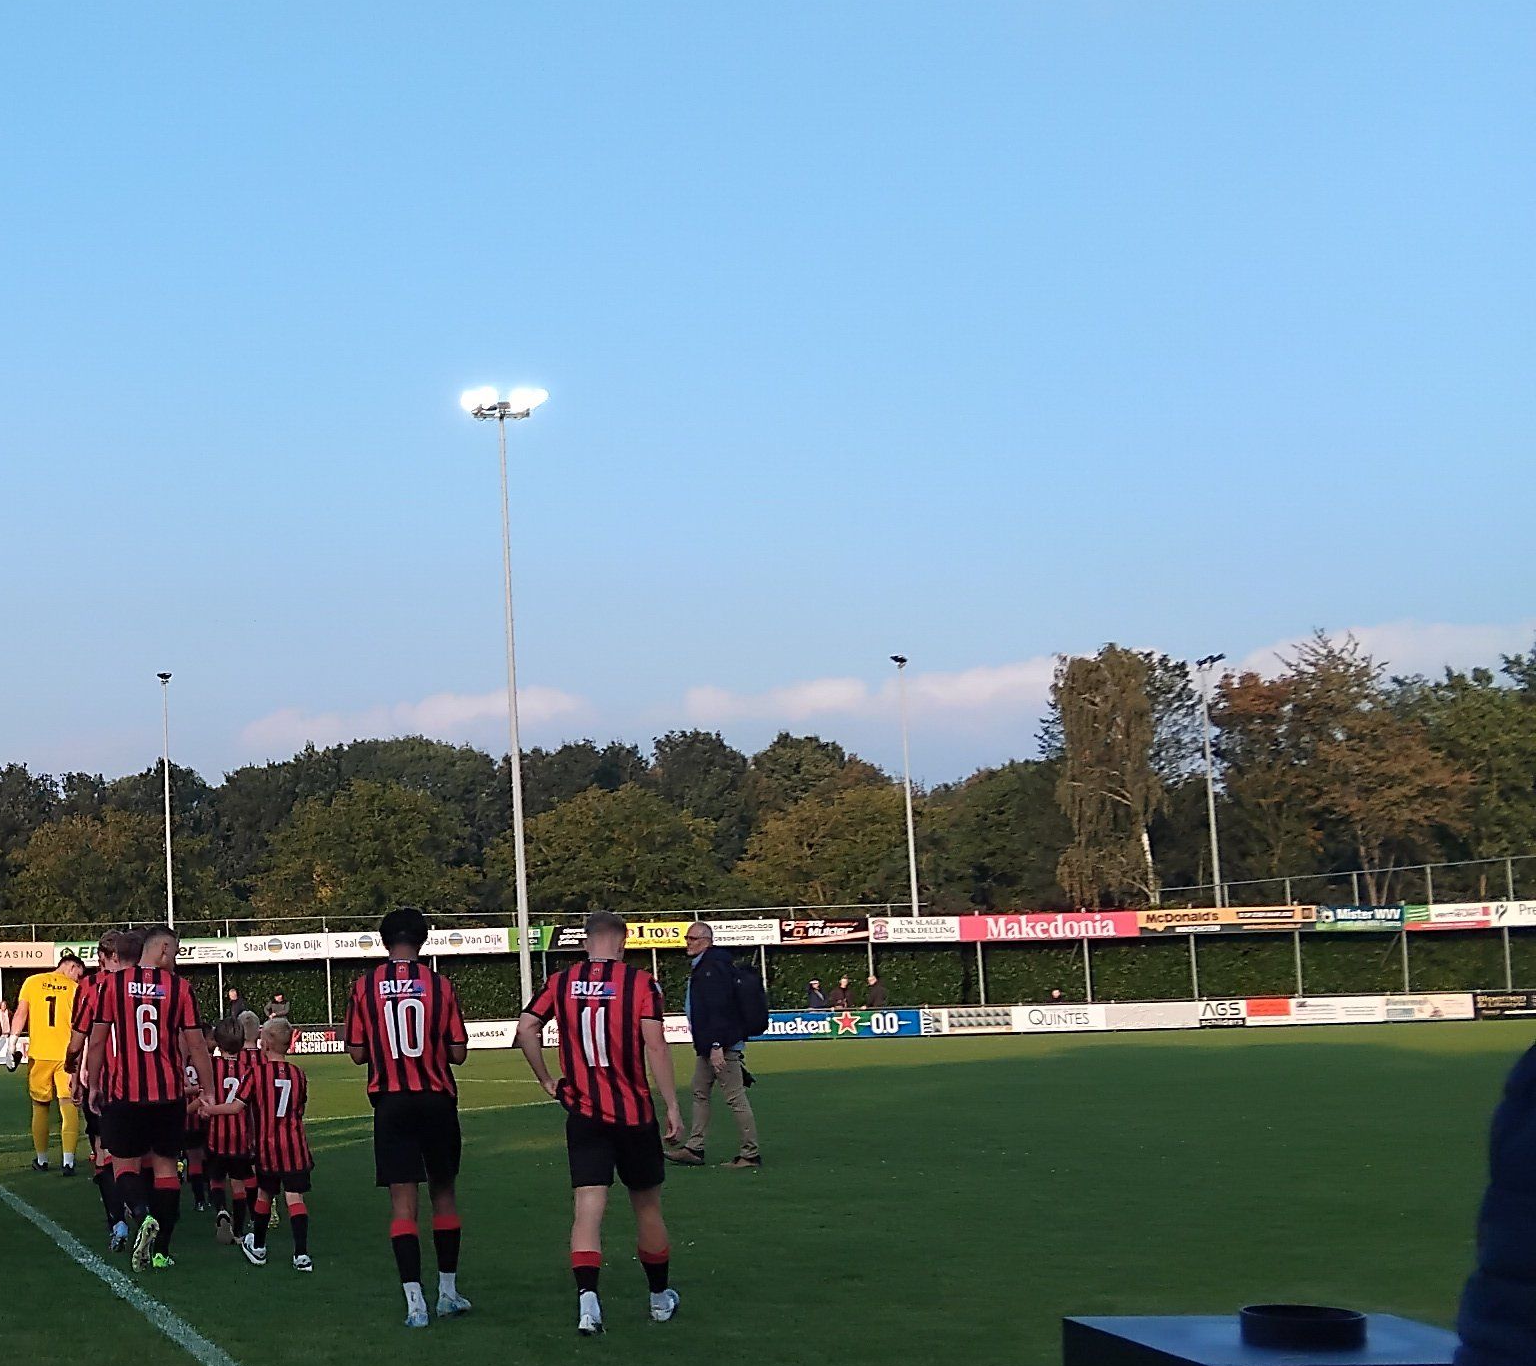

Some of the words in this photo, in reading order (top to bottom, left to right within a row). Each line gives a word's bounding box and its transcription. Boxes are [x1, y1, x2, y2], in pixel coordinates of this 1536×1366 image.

[1146, 912, 1219, 923] McDonald's
[649, 927, 679, 938] TOYS
[985, 914, 1115, 939] Makedonia
[244, 943, 266, 952] Staal
[283, 941, 301, 950] Van
[304, 940, 322, 950] Dijk
[335, 939, 357, 949] Staal
[464, 936, 481, 944] Van
[484, 935, 503, 945] Dijk
[128, 982, 155, 995] BUZ
[379, 979, 413, 995] BUZ
[571, 981, 604, 995] BUZ
[45, 996, 57, 1027] 1
[1028, 1009, 1090, 1025] QUINTES
[1201, 1002, 1241, 1017] AGS
[136, 1004, 158, 1052] 6
[384, 998, 424, 1059] 10
[763, 1017, 832, 1035] ineken
[302, 1031, 336, 1042] CROSSFIT
[581, 1006, 609, 1067] 11
[295, 1040, 344, 1054] NSCHOTEN
[274, 1078, 292, 1118] 7
